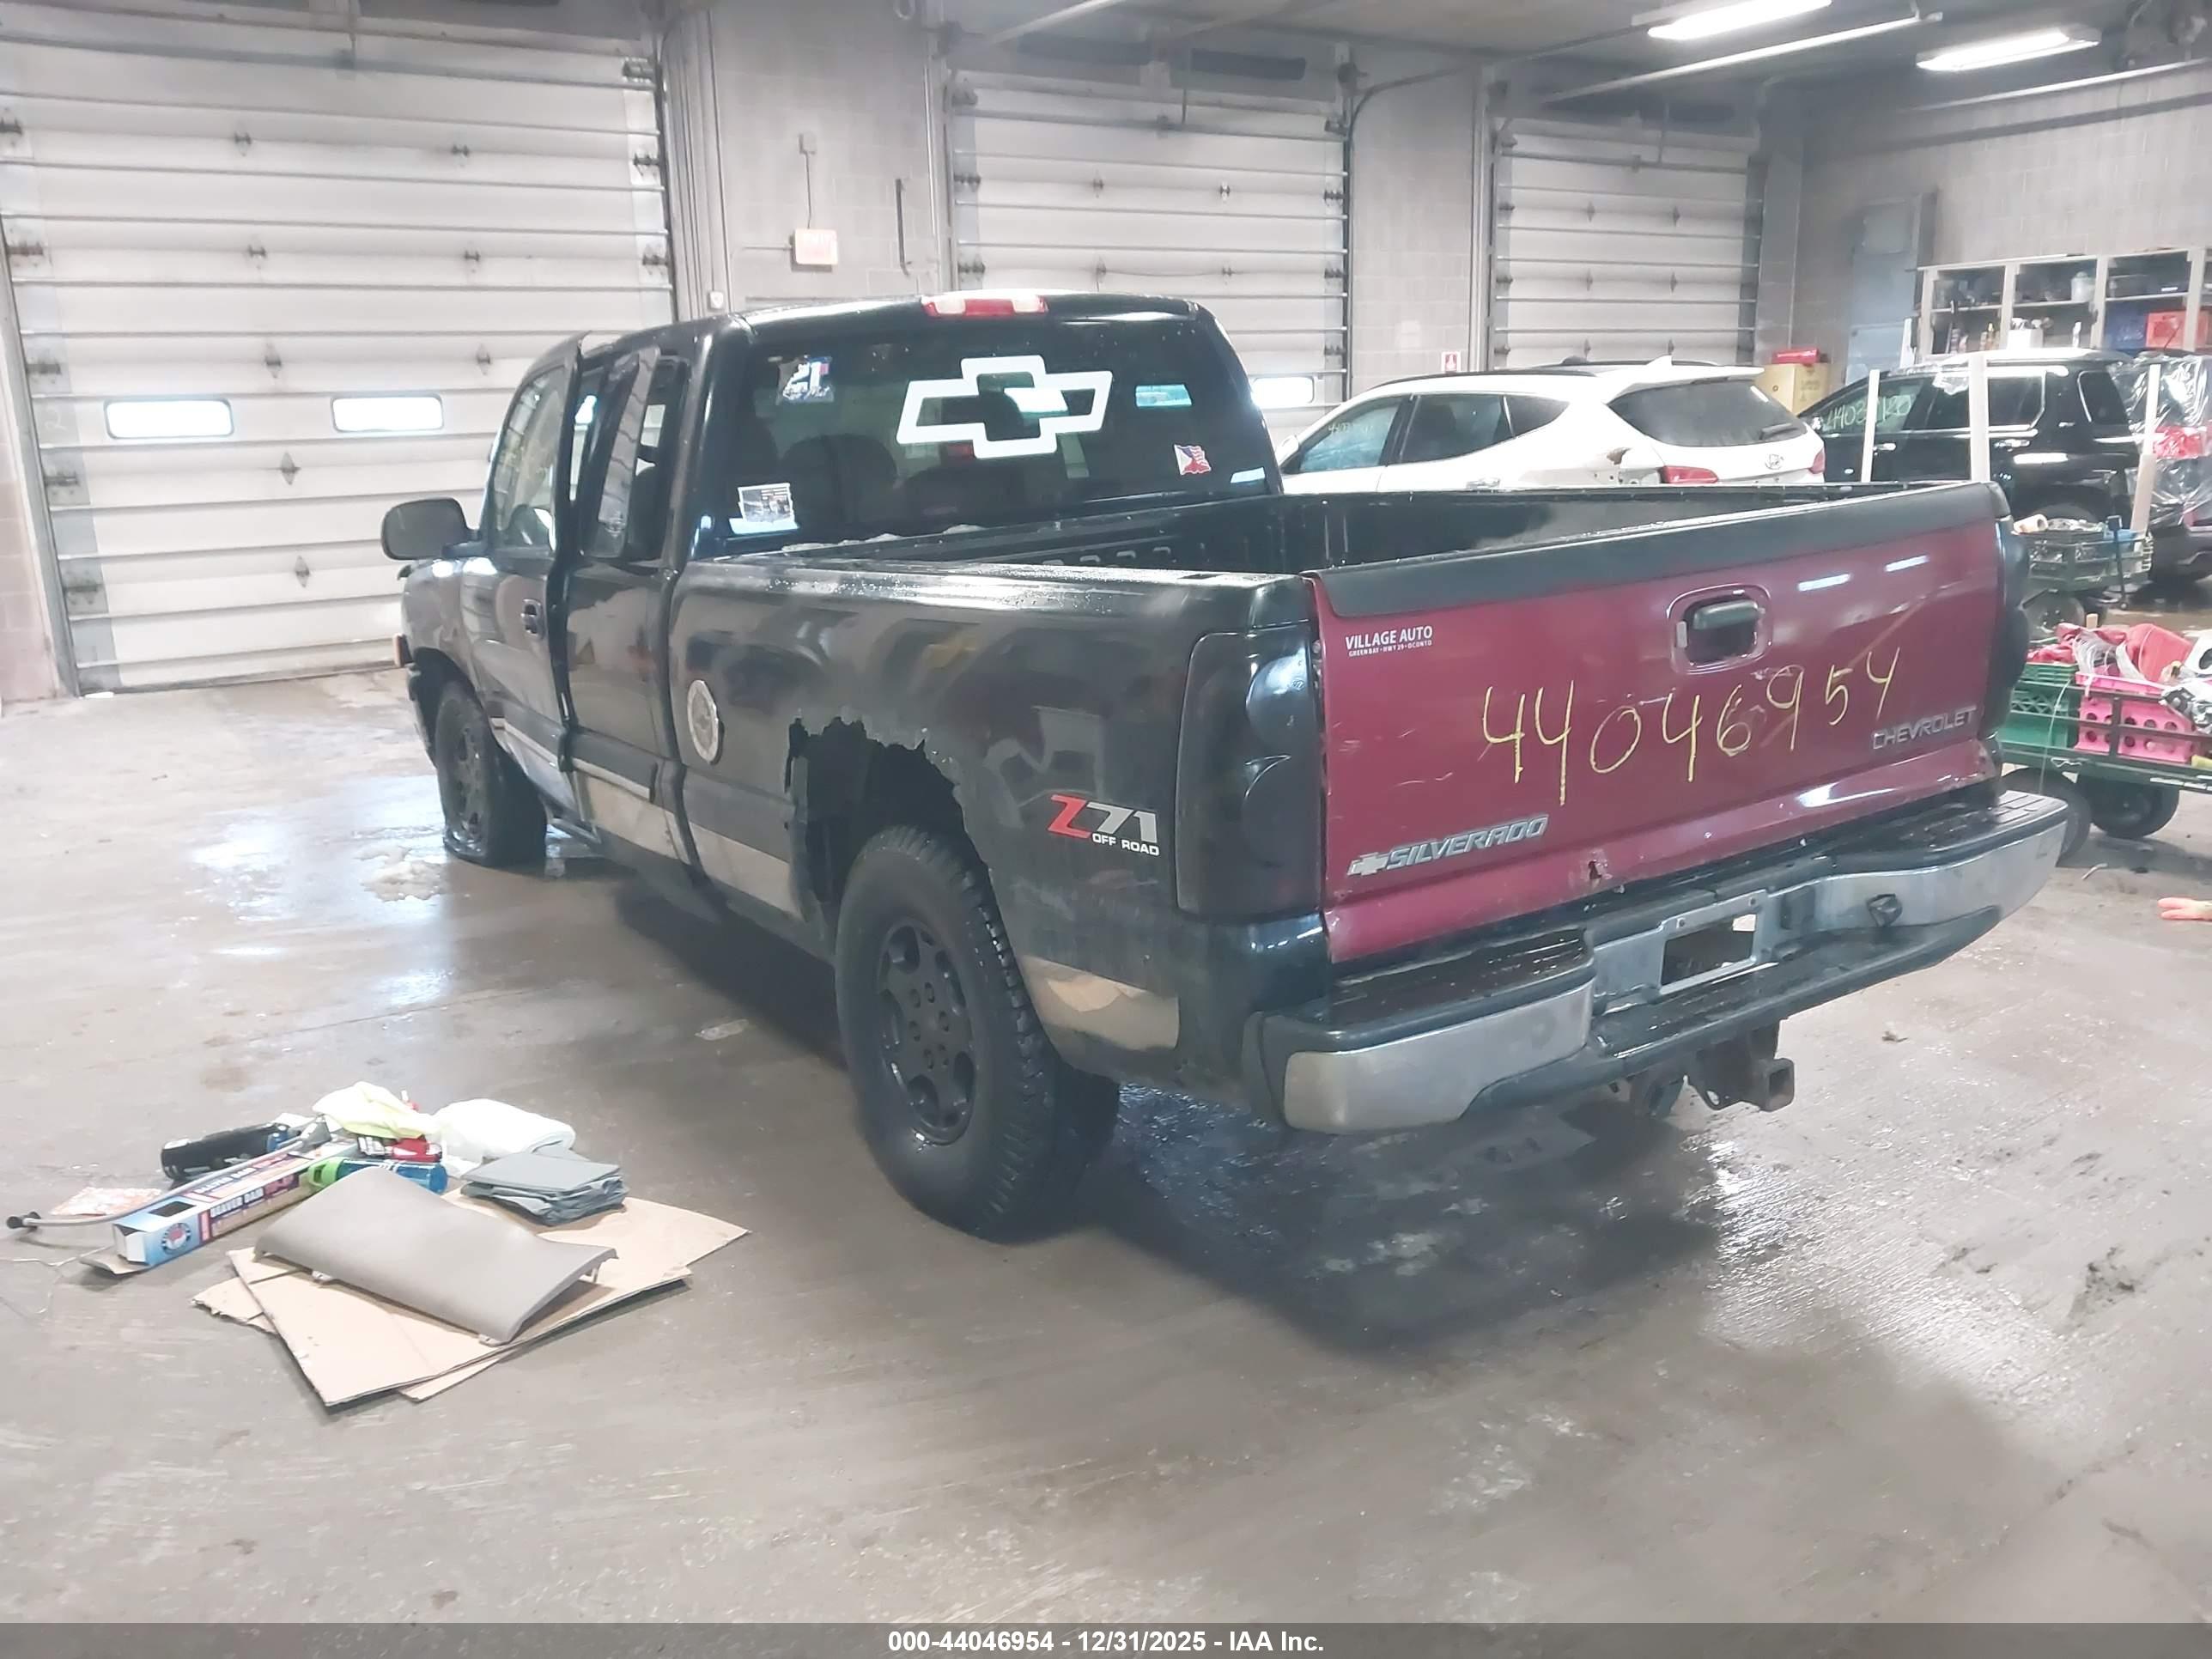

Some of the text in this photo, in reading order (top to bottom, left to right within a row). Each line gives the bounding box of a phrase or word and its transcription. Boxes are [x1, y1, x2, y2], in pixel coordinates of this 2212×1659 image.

[1345, 625, 1433, 650] VILLAGE AUTO
[1407, 640, 1432, 649] OCONTO
[1482, 647, 1901, 805] 44046954
[1872, 705, 1978, 750] CHEVROLET
[1047, 793, 1158, 844] Z71
[1091, 832, 1160, 857] OFF ROAD
[1386, 814, 1550, 871] SILVERADO
